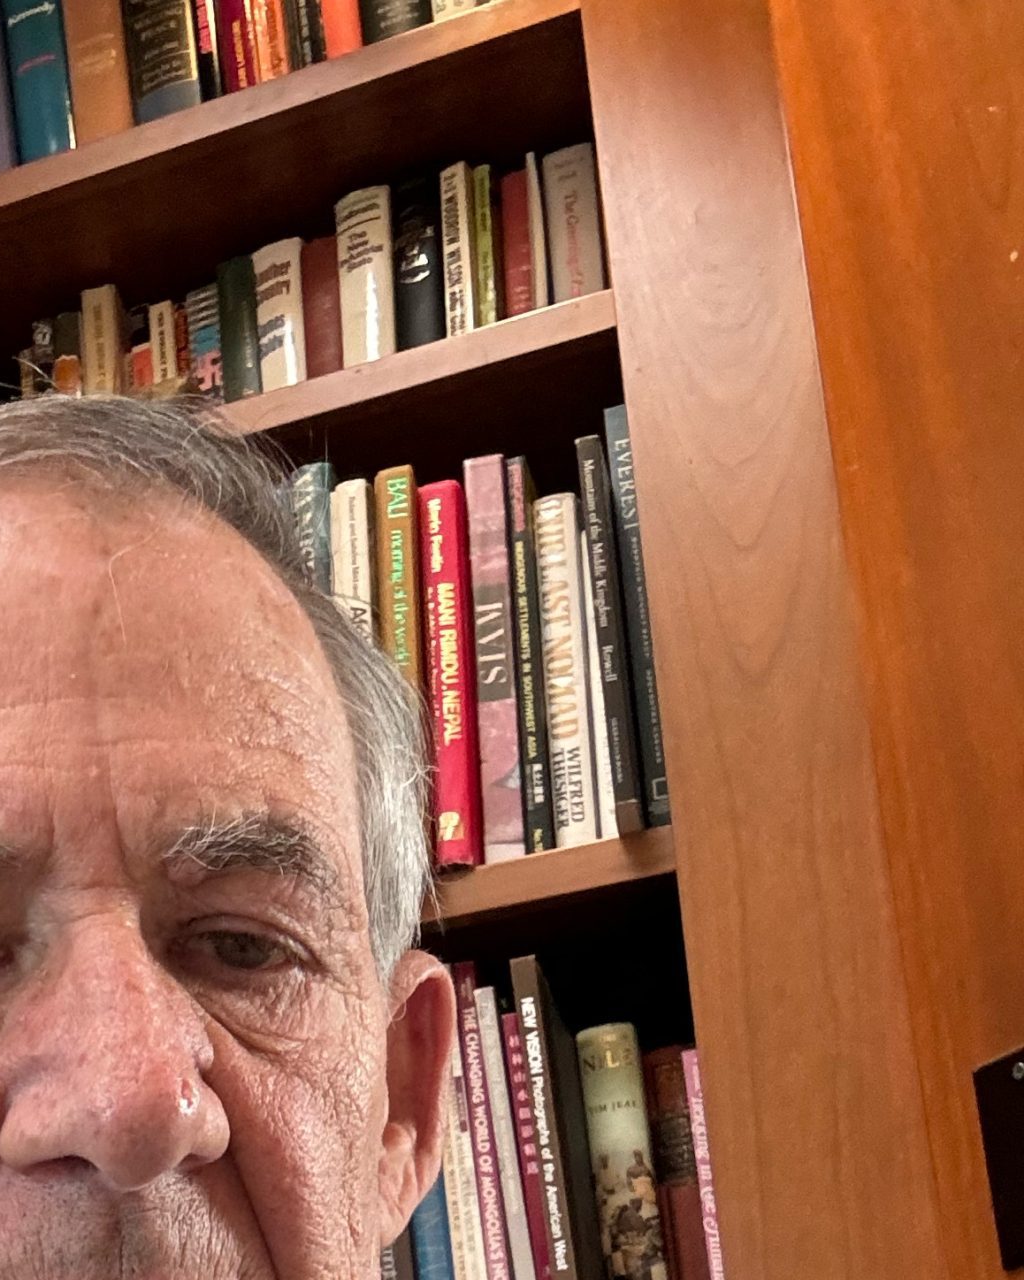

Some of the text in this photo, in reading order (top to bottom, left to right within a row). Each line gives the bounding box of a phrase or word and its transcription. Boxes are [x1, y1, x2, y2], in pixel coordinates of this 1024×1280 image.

[447, 247, 463, 288] WILSON
[384, 477, 411, 518] BALI
[614, 436, 639, 530] EVEREST
[427, 498, 444, 533] Mario
[385, 529, 408, 583] morning
[582, 459, 612, 627] Mountains of the Middle Kingdom
[513, 541, 529, 593] INDIGENOUS
[537, 550, 573, 628] LAST
[393, 602, 411, 624] the
[435, 582, 458, 626] MANI
[516, 596, 534, 659] SETTLEMENTS
[522, 663, 532, 673] IN
[602, 645, 618, 682] Rowell
[521, 676, 538, 733] SOUTHWEST
[541, 634, 583, 740] NOMAD
[526, 735, 539, 759] ASIA
[549, 748, 572, 830] THESIGER
[564, 746, 587, 823] WILFRED
[462, 1006, 478, 1032] THE
[520, 997, 538, 1029] NEW
[463, 1033, 487, 1104] CHANGING
[524, 1030, 544, 1075] VISION
[583, 1047, 633, 1071] NILE
[472, 1105, 491, 1153] WORLD
[529, 1076, 552, 1146] Photographs
[478, 1154, 493, 1174] OF
[540, 1147, 553, 1160] of
[543, 1163, 556, 1182] the
[479, 1175, 506, 1261] MONGOLIA'S
[545, 1184, 564, 1239] American
[553, 1240, 569, 1271] West
